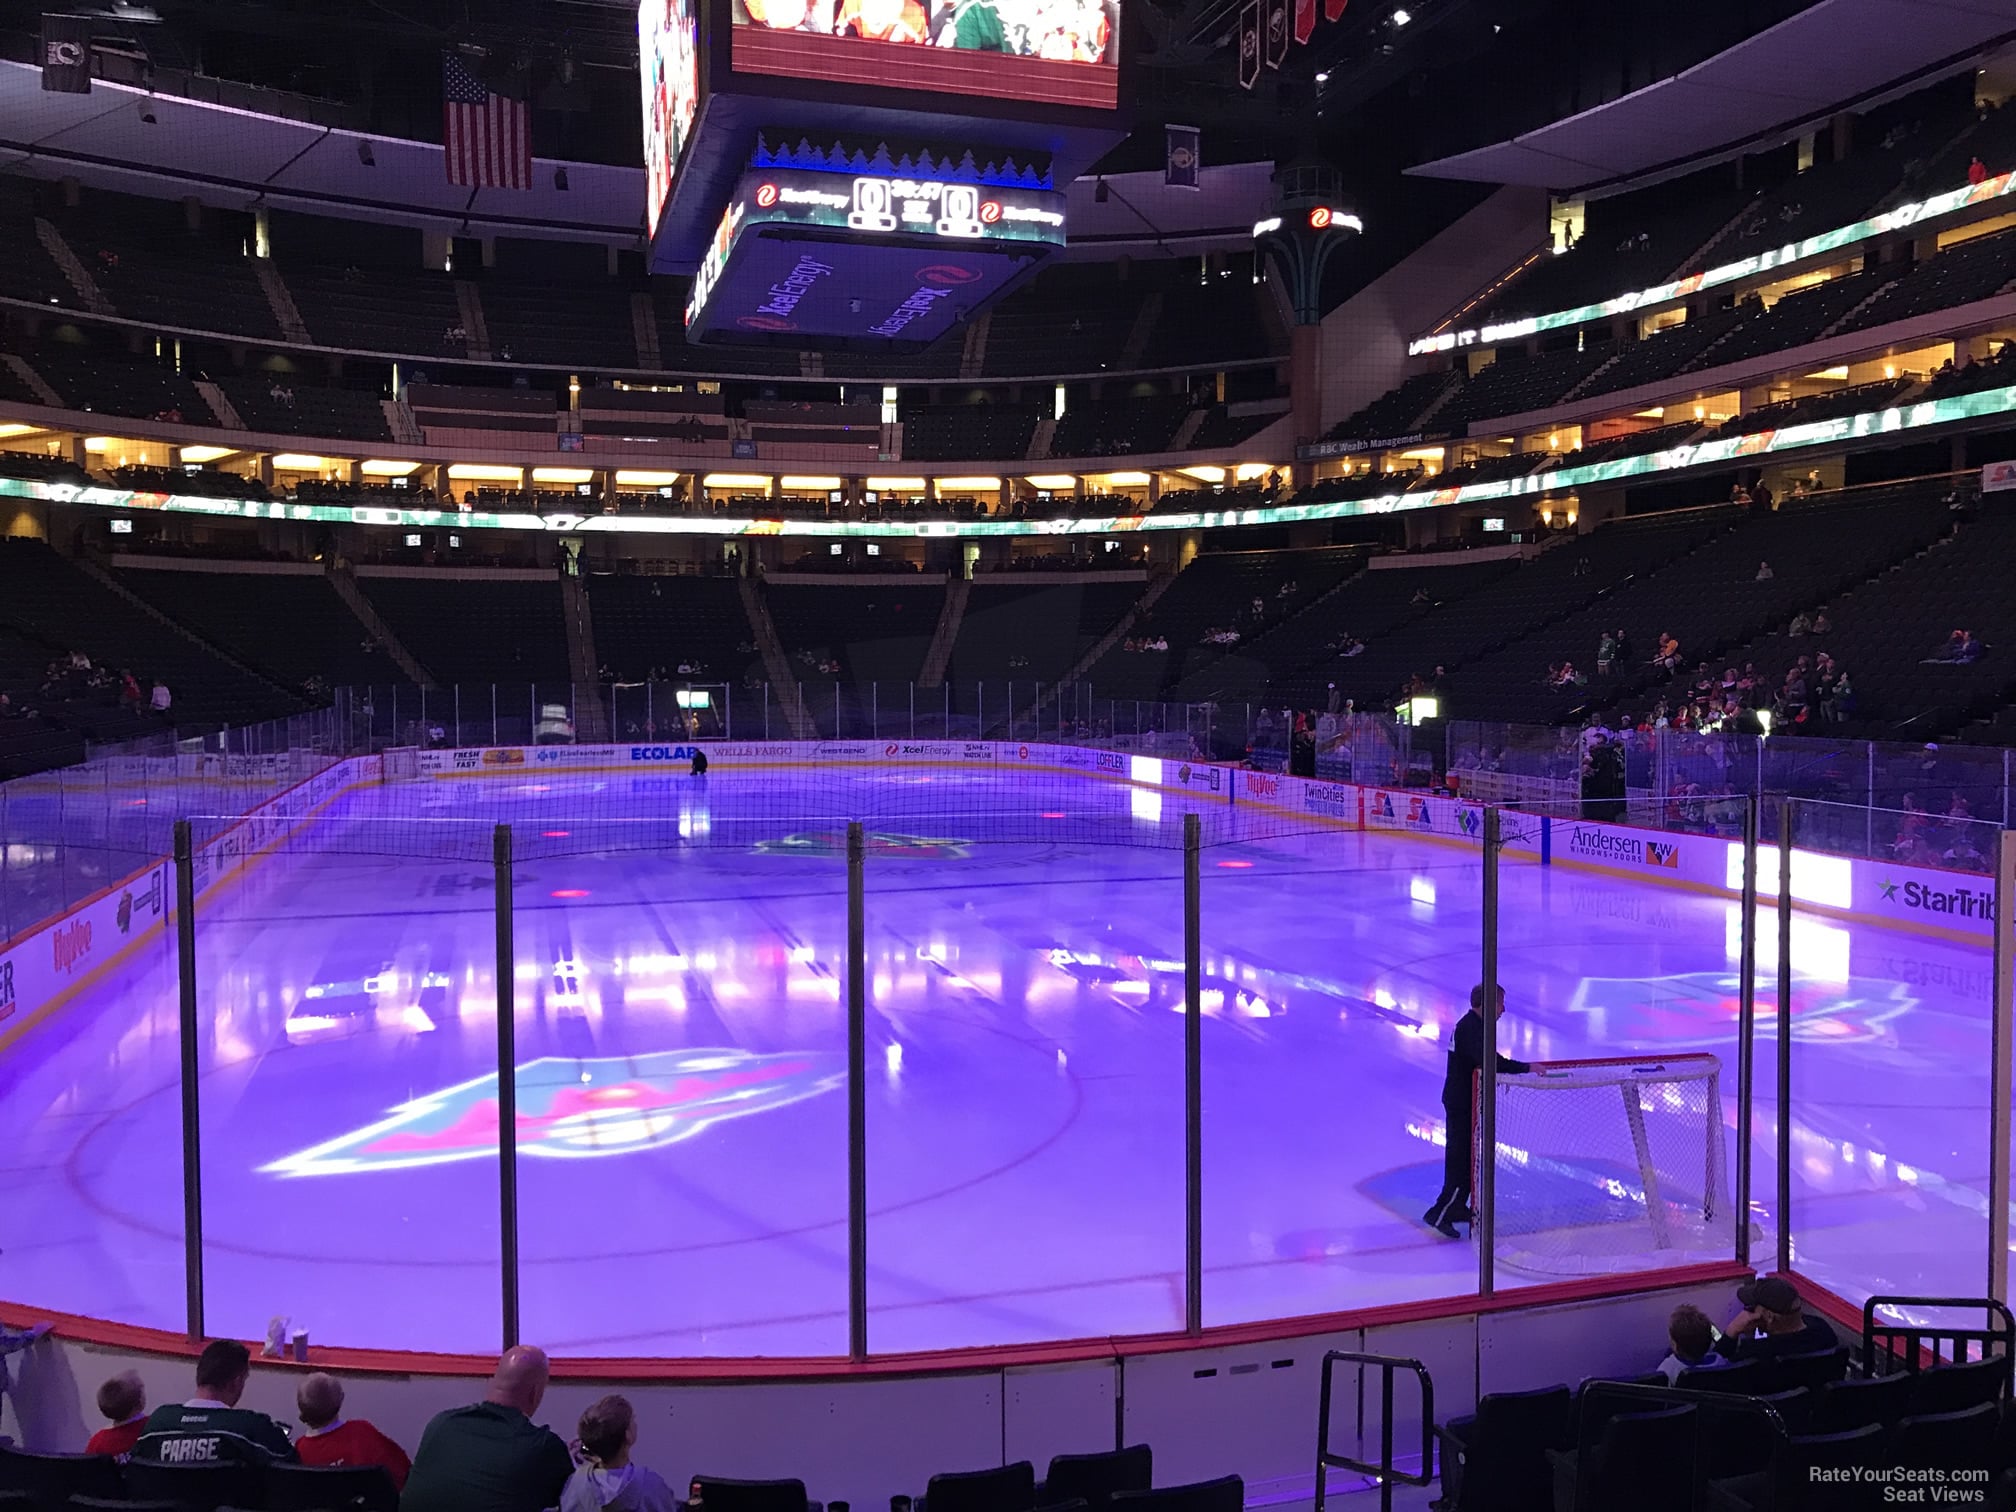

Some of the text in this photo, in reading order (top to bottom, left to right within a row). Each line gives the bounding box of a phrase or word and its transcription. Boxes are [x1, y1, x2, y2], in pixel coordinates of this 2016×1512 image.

[1320, 444, 1337, 455] RBC
[1339, 440, 1369, 451] Wealth
[1370, 433, 1423, 449] Management
[453, 751, 480, 759] FRESH
[631, 747, 698, 761] ECOLAB
[714, 746, 793, 758] WELLS FARGO
[1096, 752, 1125, 770] LOFFLER
[456, 761, 476, 769] FAST
[1304, 783, 1345, 804] TwinCities
[1570, 826, 1641, 855] Andersen
[160, 1437, 221, 1462] PARISE
